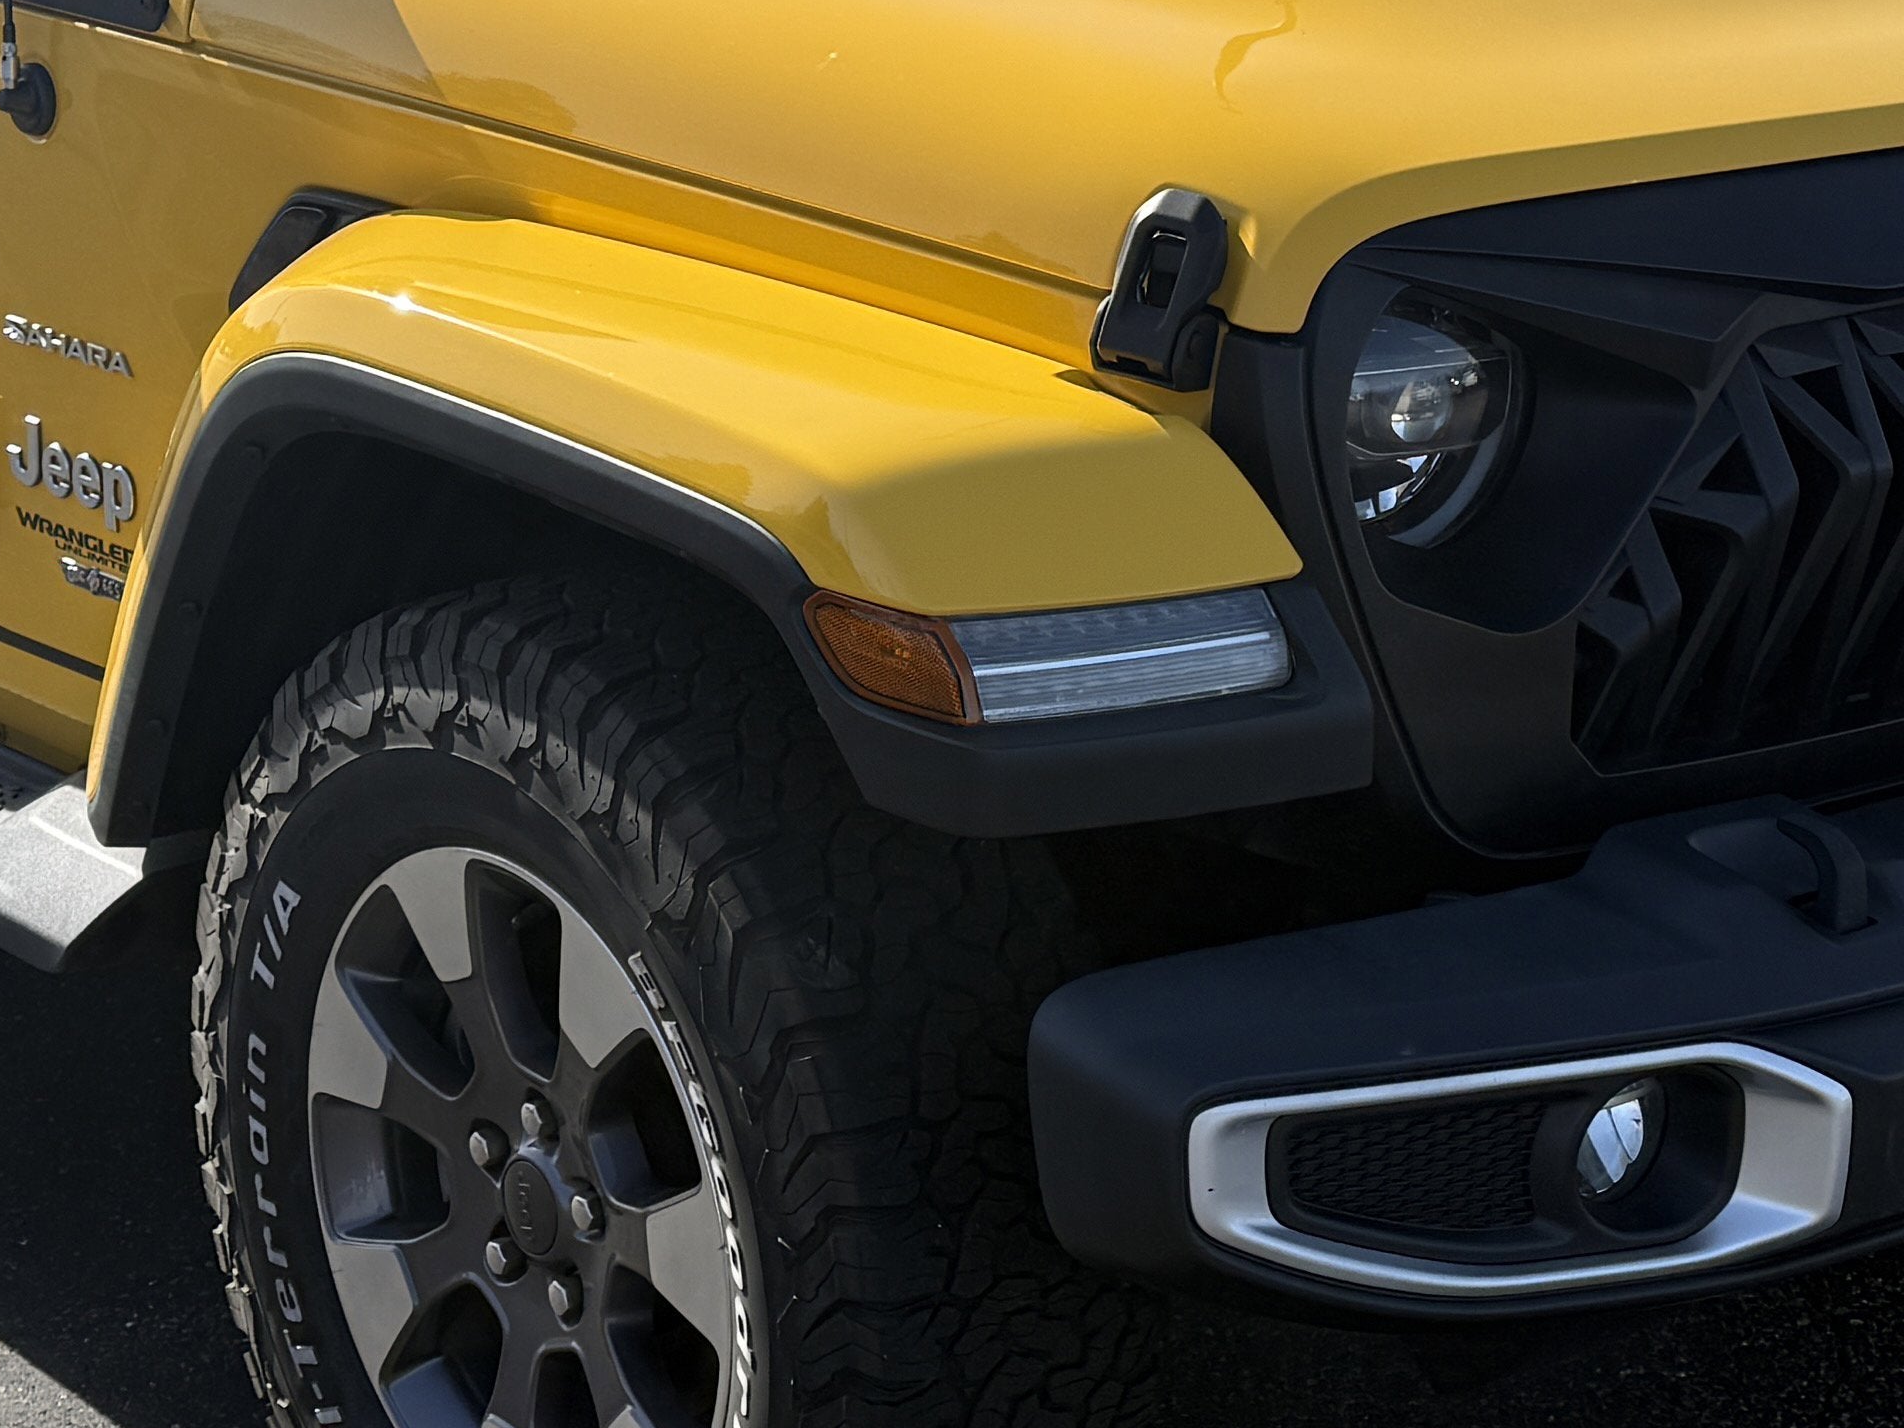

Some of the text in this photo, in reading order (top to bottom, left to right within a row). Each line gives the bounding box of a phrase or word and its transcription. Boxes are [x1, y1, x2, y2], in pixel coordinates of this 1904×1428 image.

[1, 313, 134, 379] SAHARA
[6, 414, 137, 533] Jeep
[55, 539, 129, 574] UNLIMITE
[248, 875, 304, 993] T/A
